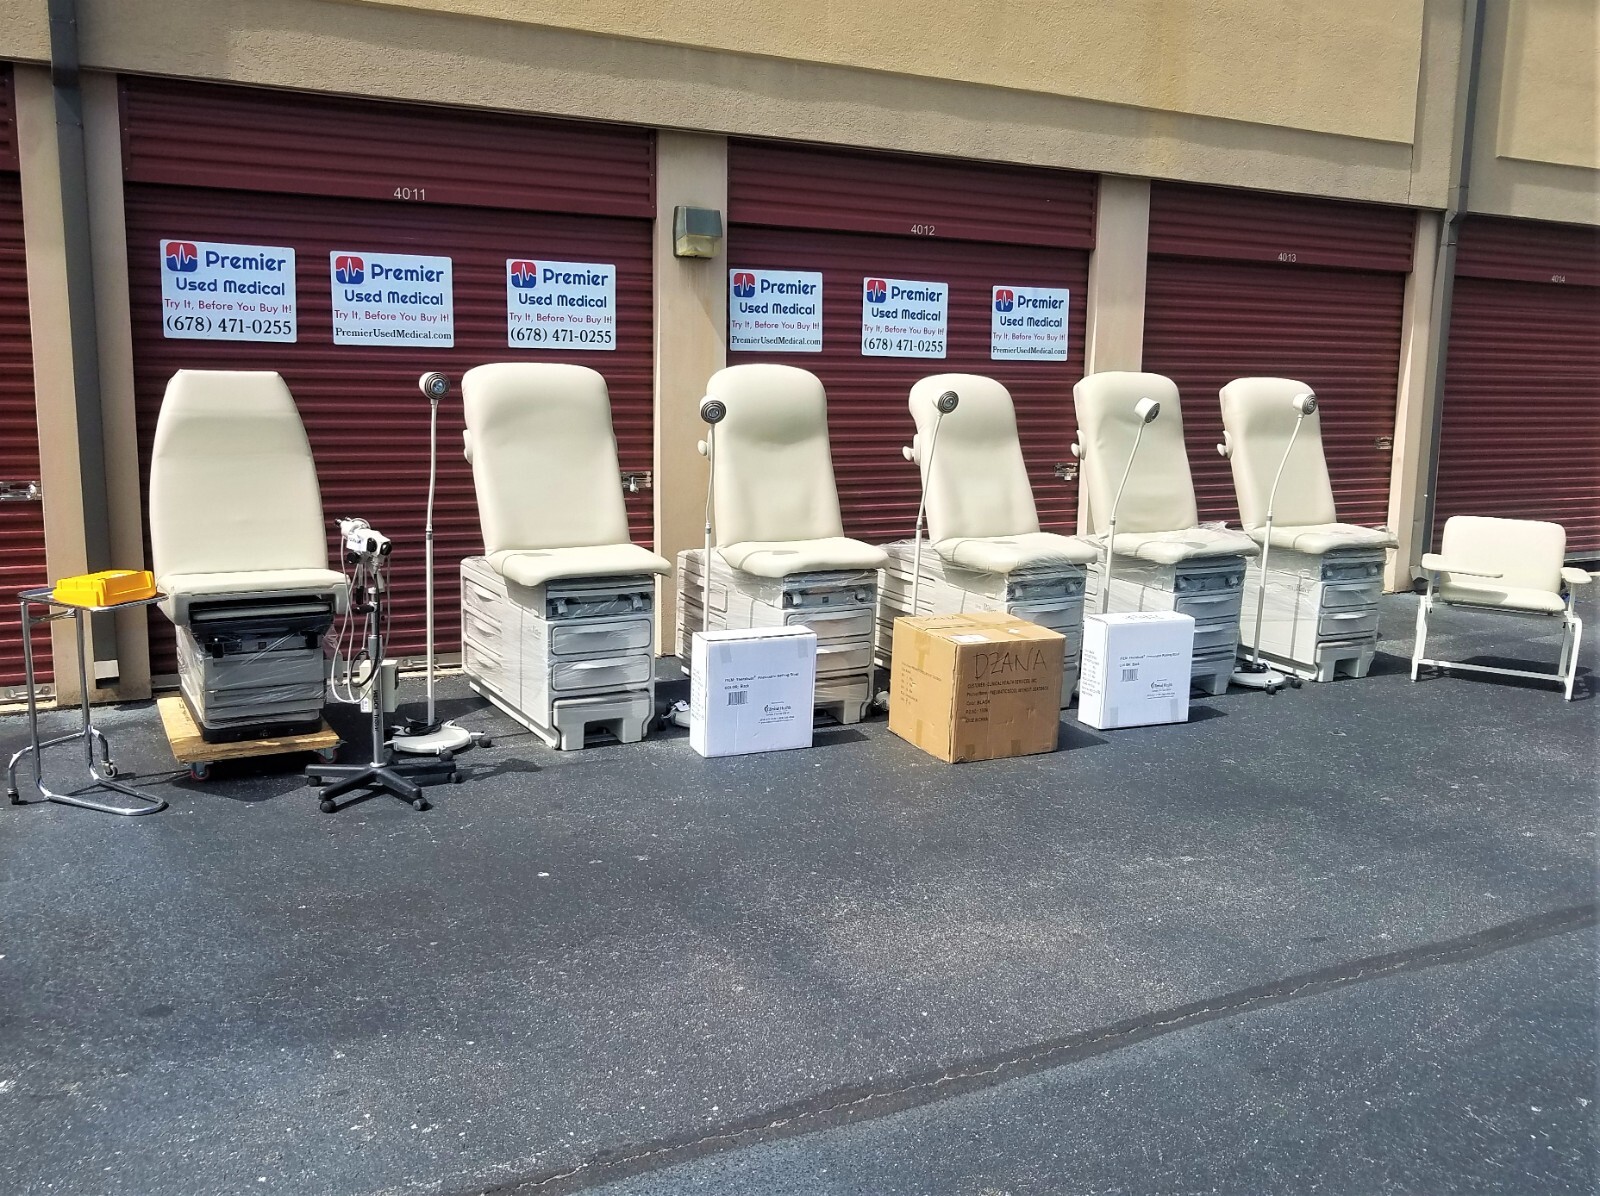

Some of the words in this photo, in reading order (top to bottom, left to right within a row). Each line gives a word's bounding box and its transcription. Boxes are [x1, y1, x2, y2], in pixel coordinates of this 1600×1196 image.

[393, 187, 425, 201] 4011
[911, 224, 935, 235] 4012
[205, 250, 286, 272] Premier
[1278, 252, 1297, 263] 4013
[371, 263, 444, 282] Premier
[543, 268, 608, 286] Premier
[176, 276, 217, 292] Used
[223, 279, 285, 296] Medical
[760, 279, 816, 295] Premier
[344, 289, 382, 303] Used
[387, 291, 443, 305] Medical
[518, 293, 553, 306] Used
[557, 294, 607, 308] Medical
[891, 285, 942, 302] Premier
[164, 298, 180, 310] Try
[184, 300, 194, 310] It,
[198, 300, 233, 311] Before
[236, 301, 256, 312] You
[259, 302, 278, 315] Buy
[282, 304, 292, 313] It!
[739, 302, 768, 314] Used
[772, 303, 815, 315] Medical
[1017, 295, 1064, 309] Premier
[334, 309, 349, 321] Try
[352, 310, 361, 321] It,
[364, 310, 397, 321] Before
[399, 312, 417, 321] You
[420, 313, 437, 324] Buy
[440, 313, 449, 322] It!
[509, 312, 522, 323] Try
[525, 313, 534, 323] It,
[536, 313, 565, 322] Before
[567, 314, 583, 323] You
[586, 315, 601, 325] Buy
[604, 316, 612, 324] It!
[871, 307, 898, 319] Used
[901, 309, 941, 321] Medical
[166, 315, 212, 333] (678)
[218, 318, 292, 335] 471-0255
[731, 320, 742, 330] Try
[754, 320, 779, 329] Before
[781, 321, 795, 330] You
[796, 322, 810, 331] Buy
[999, 316, 1024, 326] Used
[1026, 316, 1062, 328] Medical
[335, 327, 452, 340] PremierUsedMedical.com
[510, 327, 548, 342] (678)
[552, 329, 612, 344] 471-0255
[864, 324, 873, 333] Try
[884, 325, 907, 334] Before
[909, 326, 922, 335] You
[923, 327, 936, 336] Buy
[993, 332, 1002, 342] Try
[1011, 332, 1032, 340] Before
[1046, 333, 1058, 342] Buy
[731, 336, 821, 345] PremierUsedMedical.com
[864, 337, 893, 351] (678)
[896, 339, 943, 353] 471-0255
[992, 345, 1066, 355] PremierUsedMedical.com
[973, 647, 1047, 680] DZANA
